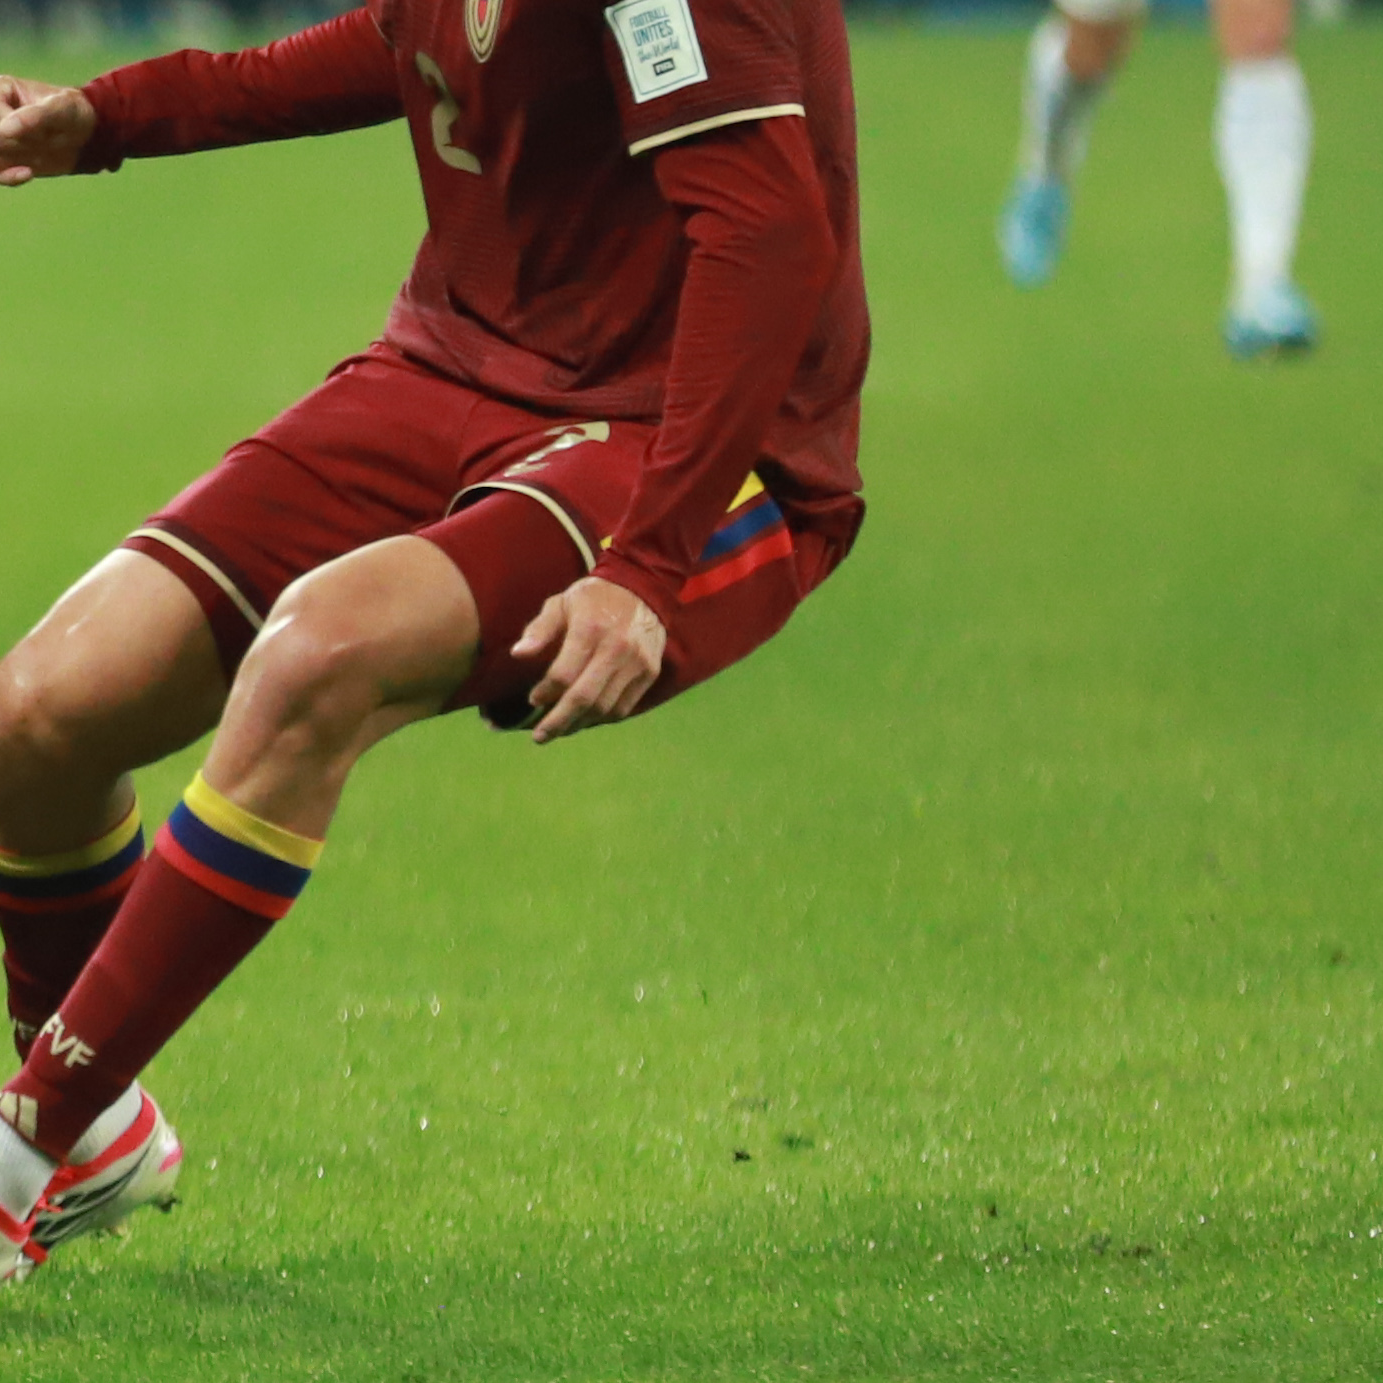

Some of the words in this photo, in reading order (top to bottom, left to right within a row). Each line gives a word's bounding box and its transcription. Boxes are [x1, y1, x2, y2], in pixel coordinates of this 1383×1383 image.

[629, 6, 669, 28] FOOTBALL
[633, 19, 674, 47] UNITES
[415, 51, 482, 175] 2
[40, 1012, 96, 1069] FVF
